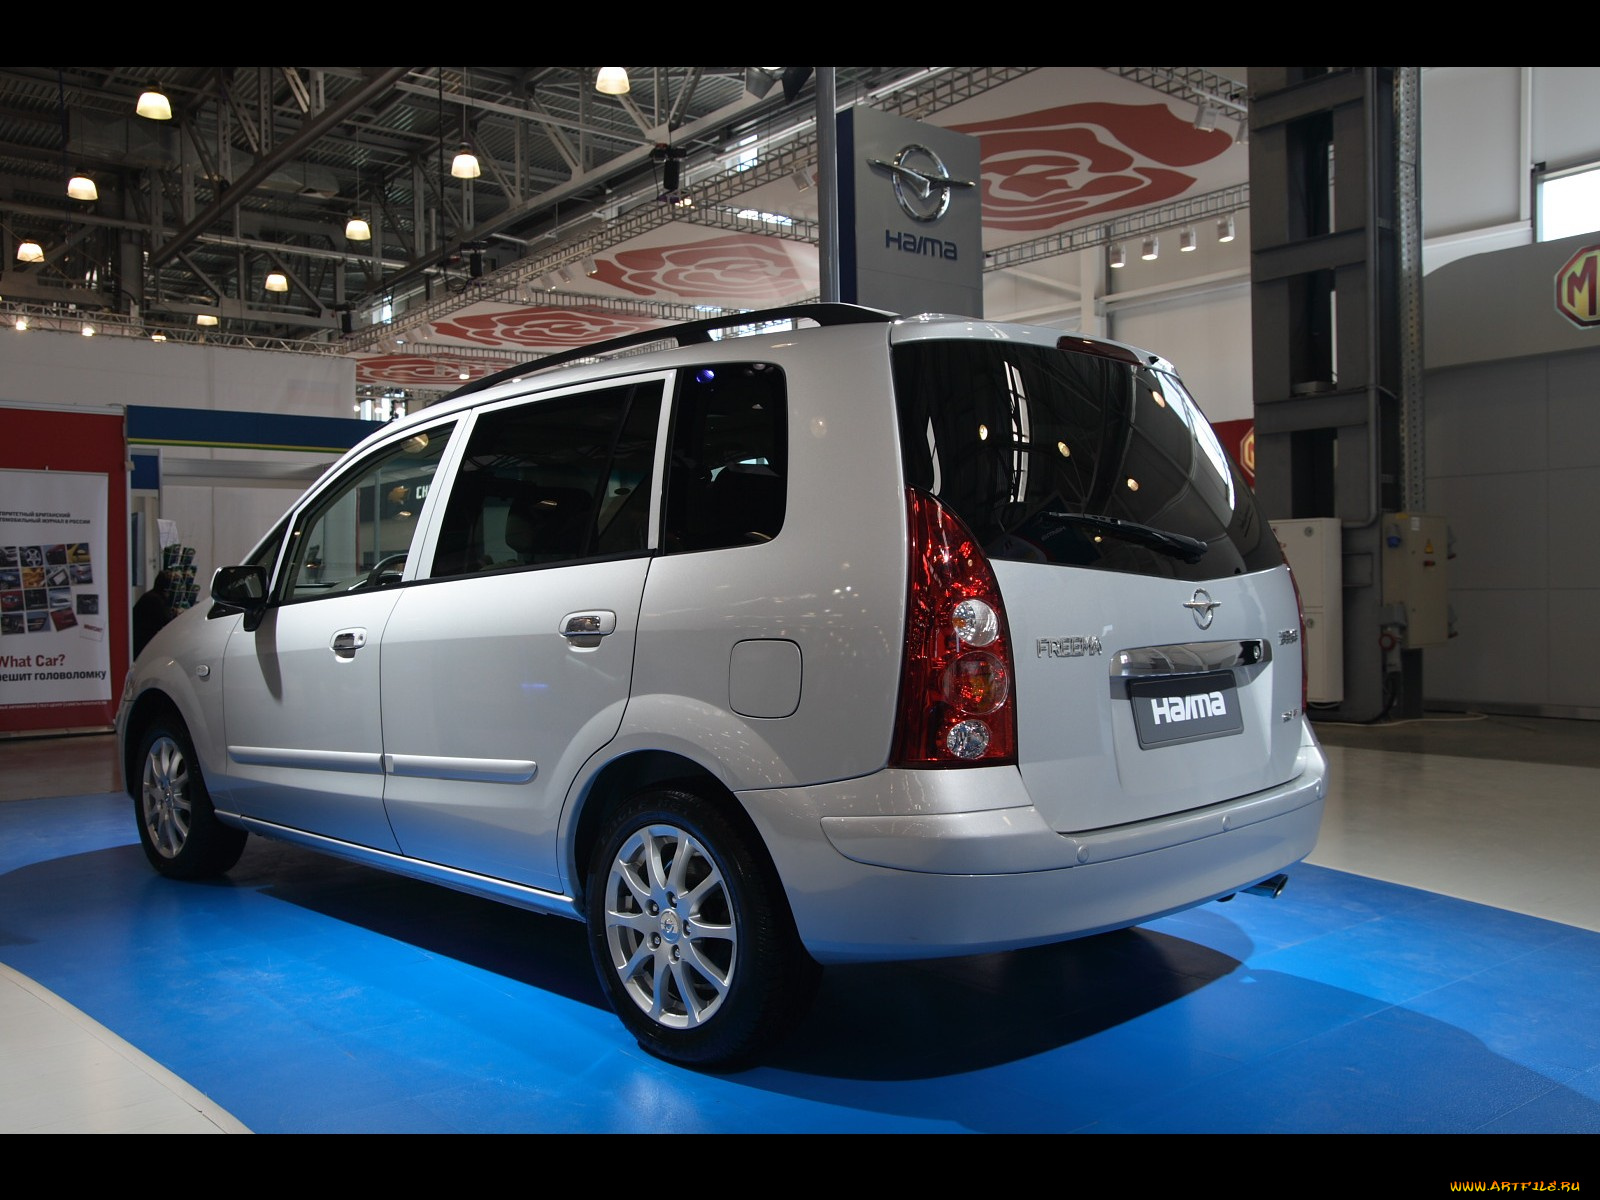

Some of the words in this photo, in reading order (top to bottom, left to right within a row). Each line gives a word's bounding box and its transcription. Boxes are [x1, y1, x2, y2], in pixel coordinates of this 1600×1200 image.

[1036, 634, 1103, 659] FREEMA
[0, 655, 32, 668] What
[36, 654, 66, 668] Car?
[34, 670, 107, 681] головоломку
